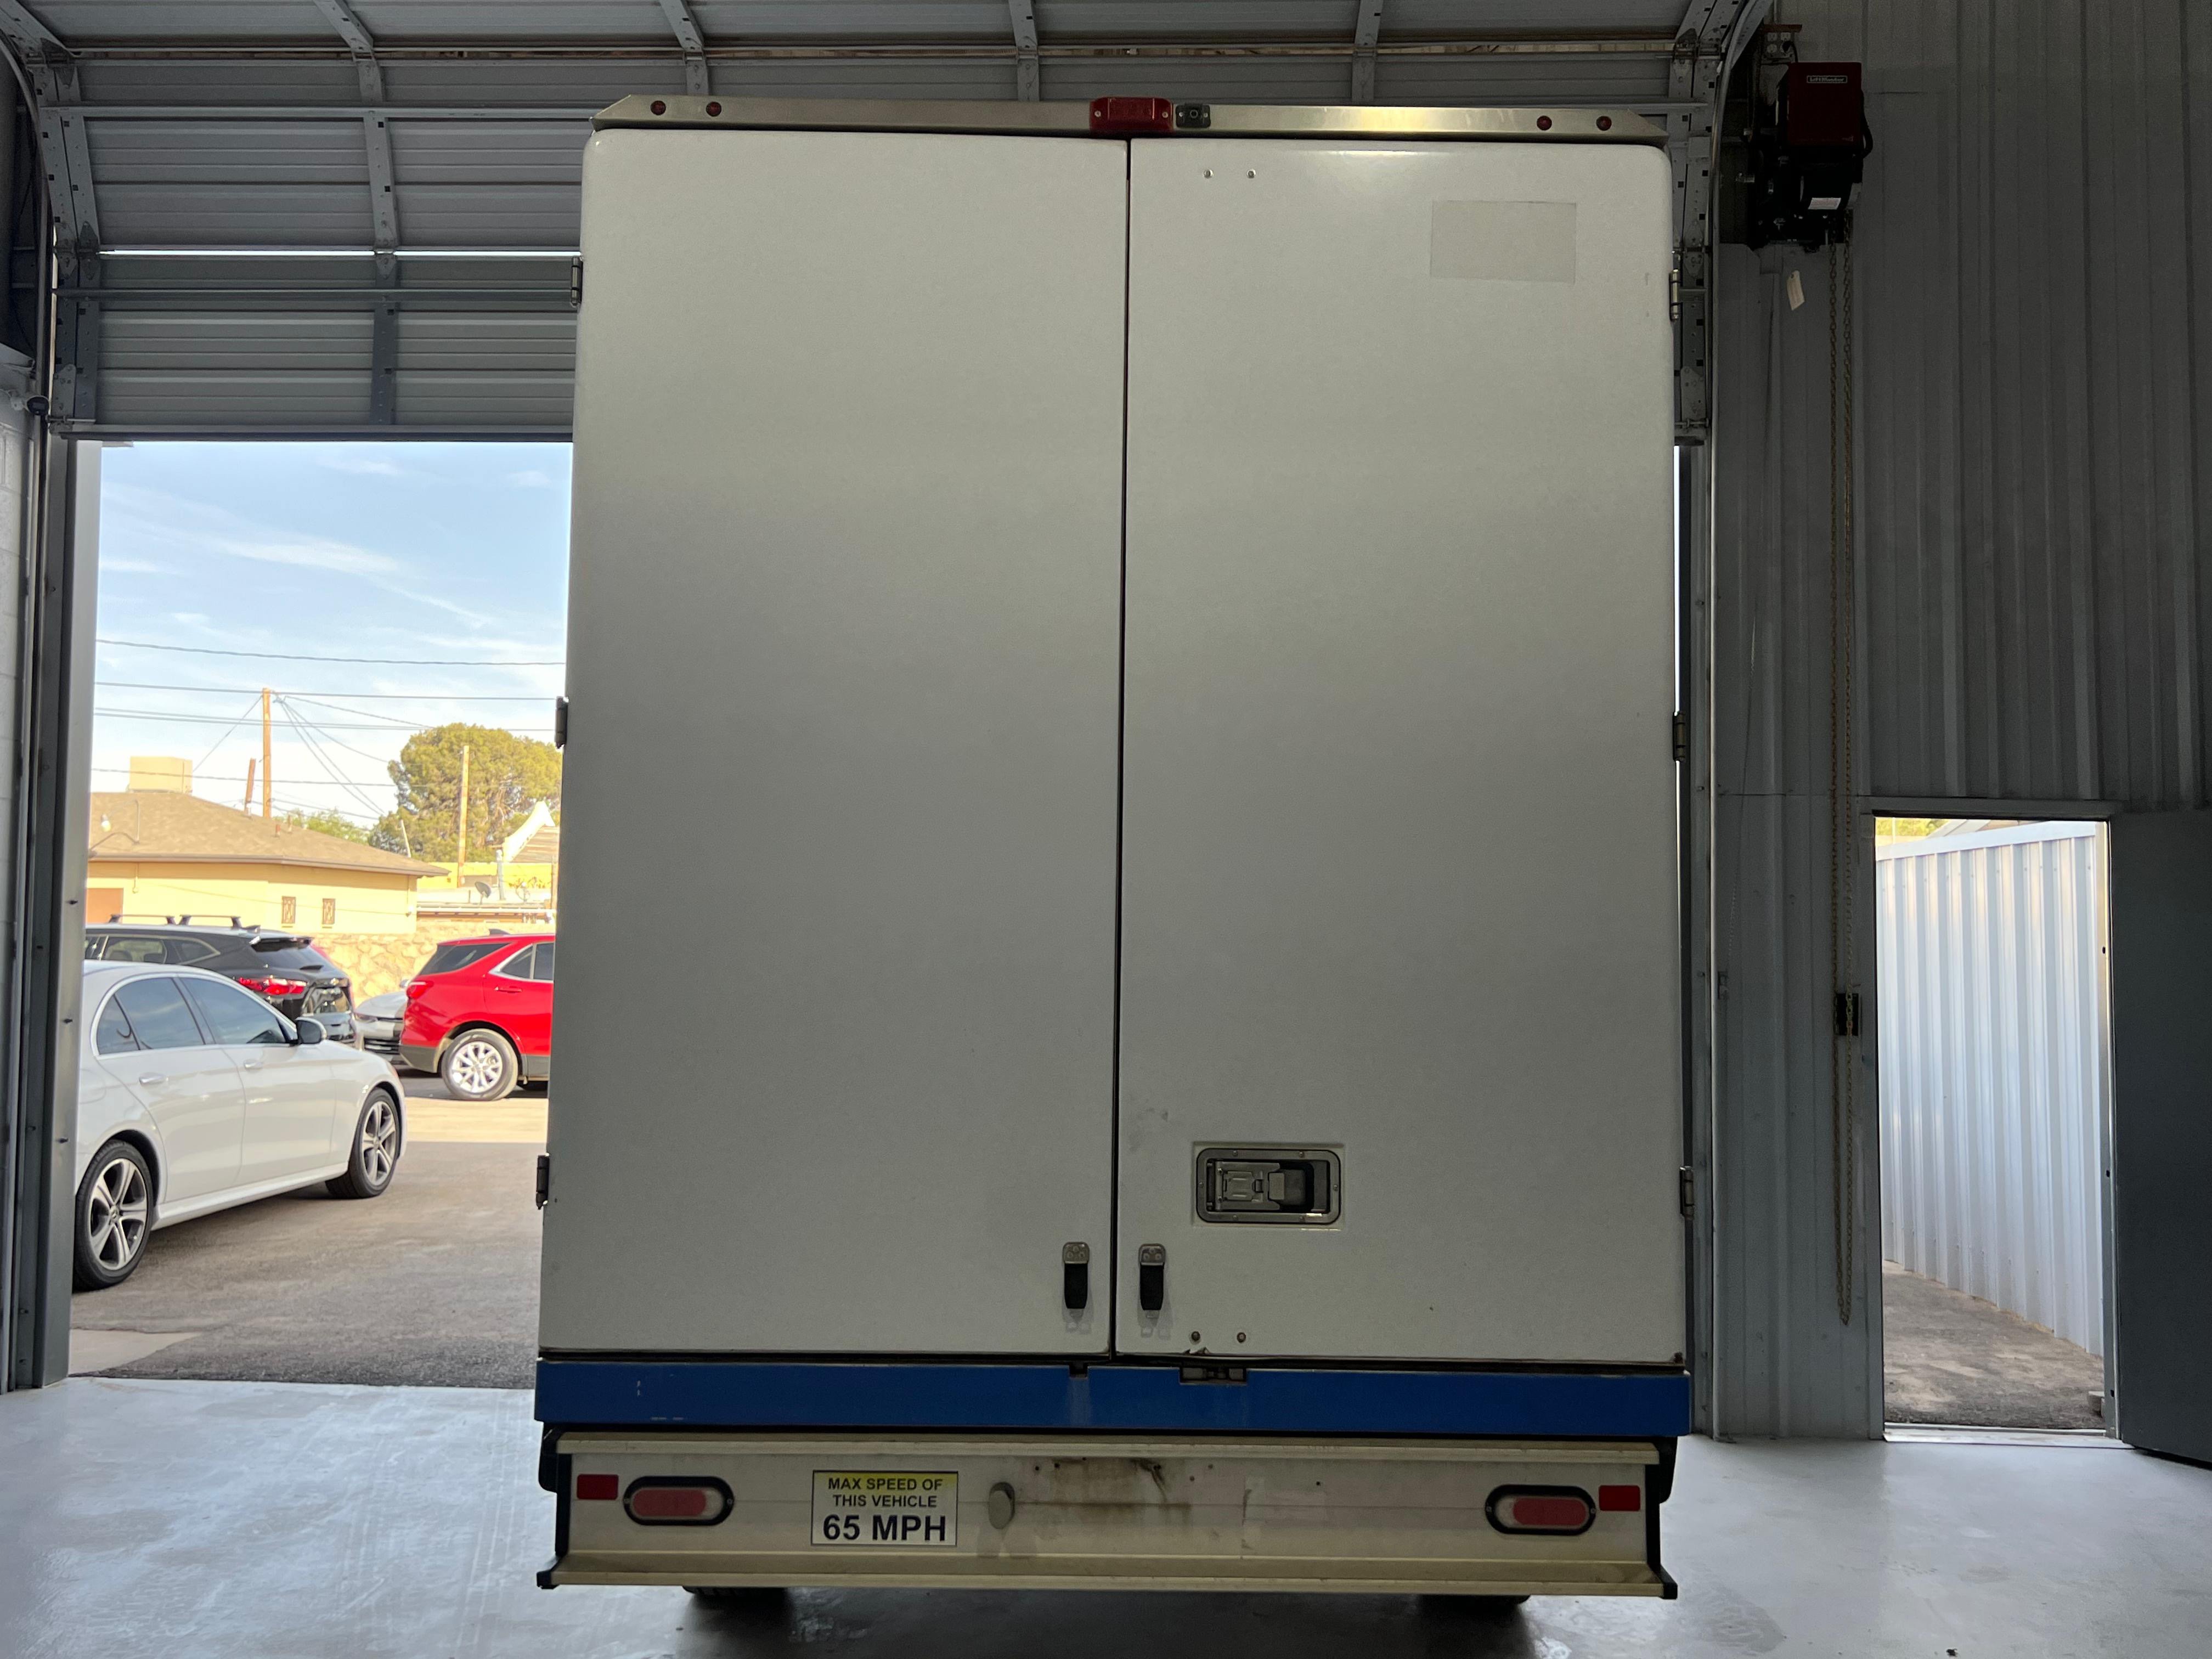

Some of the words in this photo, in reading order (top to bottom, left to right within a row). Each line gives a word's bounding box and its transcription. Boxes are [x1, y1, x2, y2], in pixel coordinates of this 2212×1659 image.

[828, 1477, 861, 1490] MAX
[866, 1478, 917, 1491] SPEED
[922, 1479, 943, 1491] OF
[833, 1494, 867, 1507] THIS
[872, 1495, 937, 1508] VEHICLE
[823, 1514, 860, 1541] 65
[872, 1515, 946, 1542] MPH
